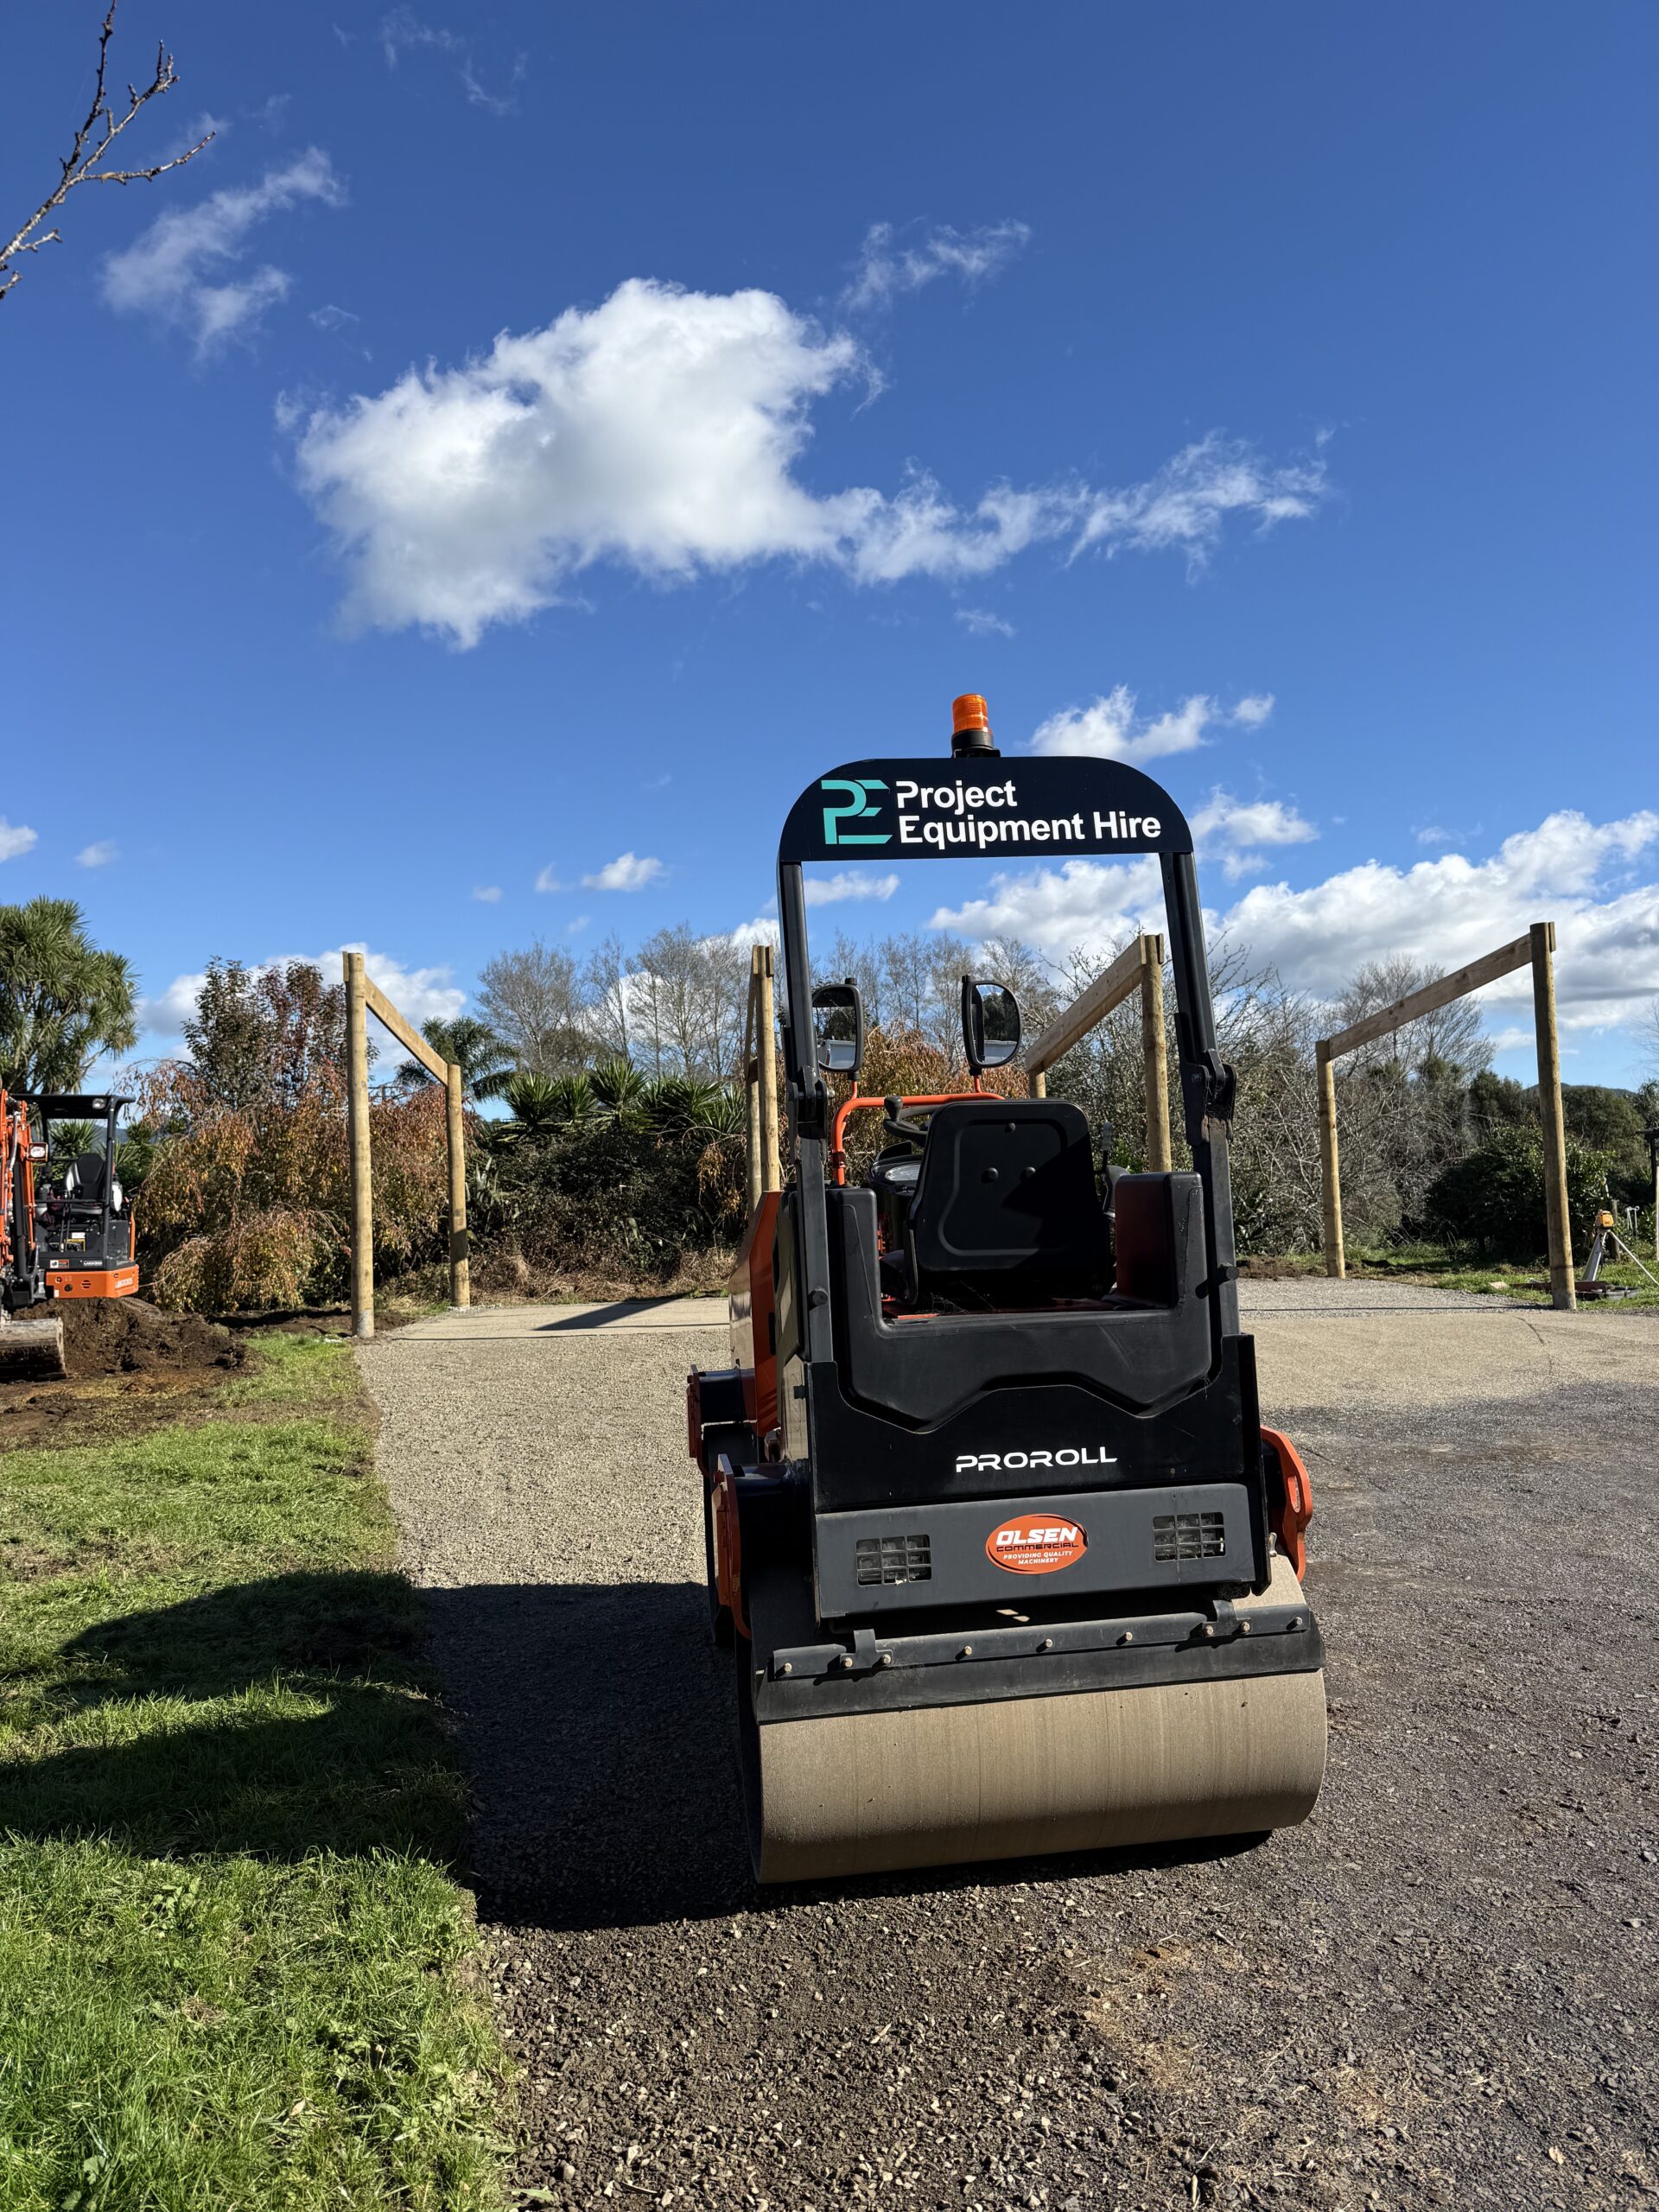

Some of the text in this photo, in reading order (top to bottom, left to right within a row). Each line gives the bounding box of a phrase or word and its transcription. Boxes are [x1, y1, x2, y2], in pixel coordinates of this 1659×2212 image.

[896, 780, 1017, 815] Project
[899, 811, 1161, 849] Equipment Hire
[956, 1446, 1117, 1472] PROROLL
[996, 1526, 1078, 1546] OLSEN
[996, 1542, 1078, 1552] COMMERCIAL
